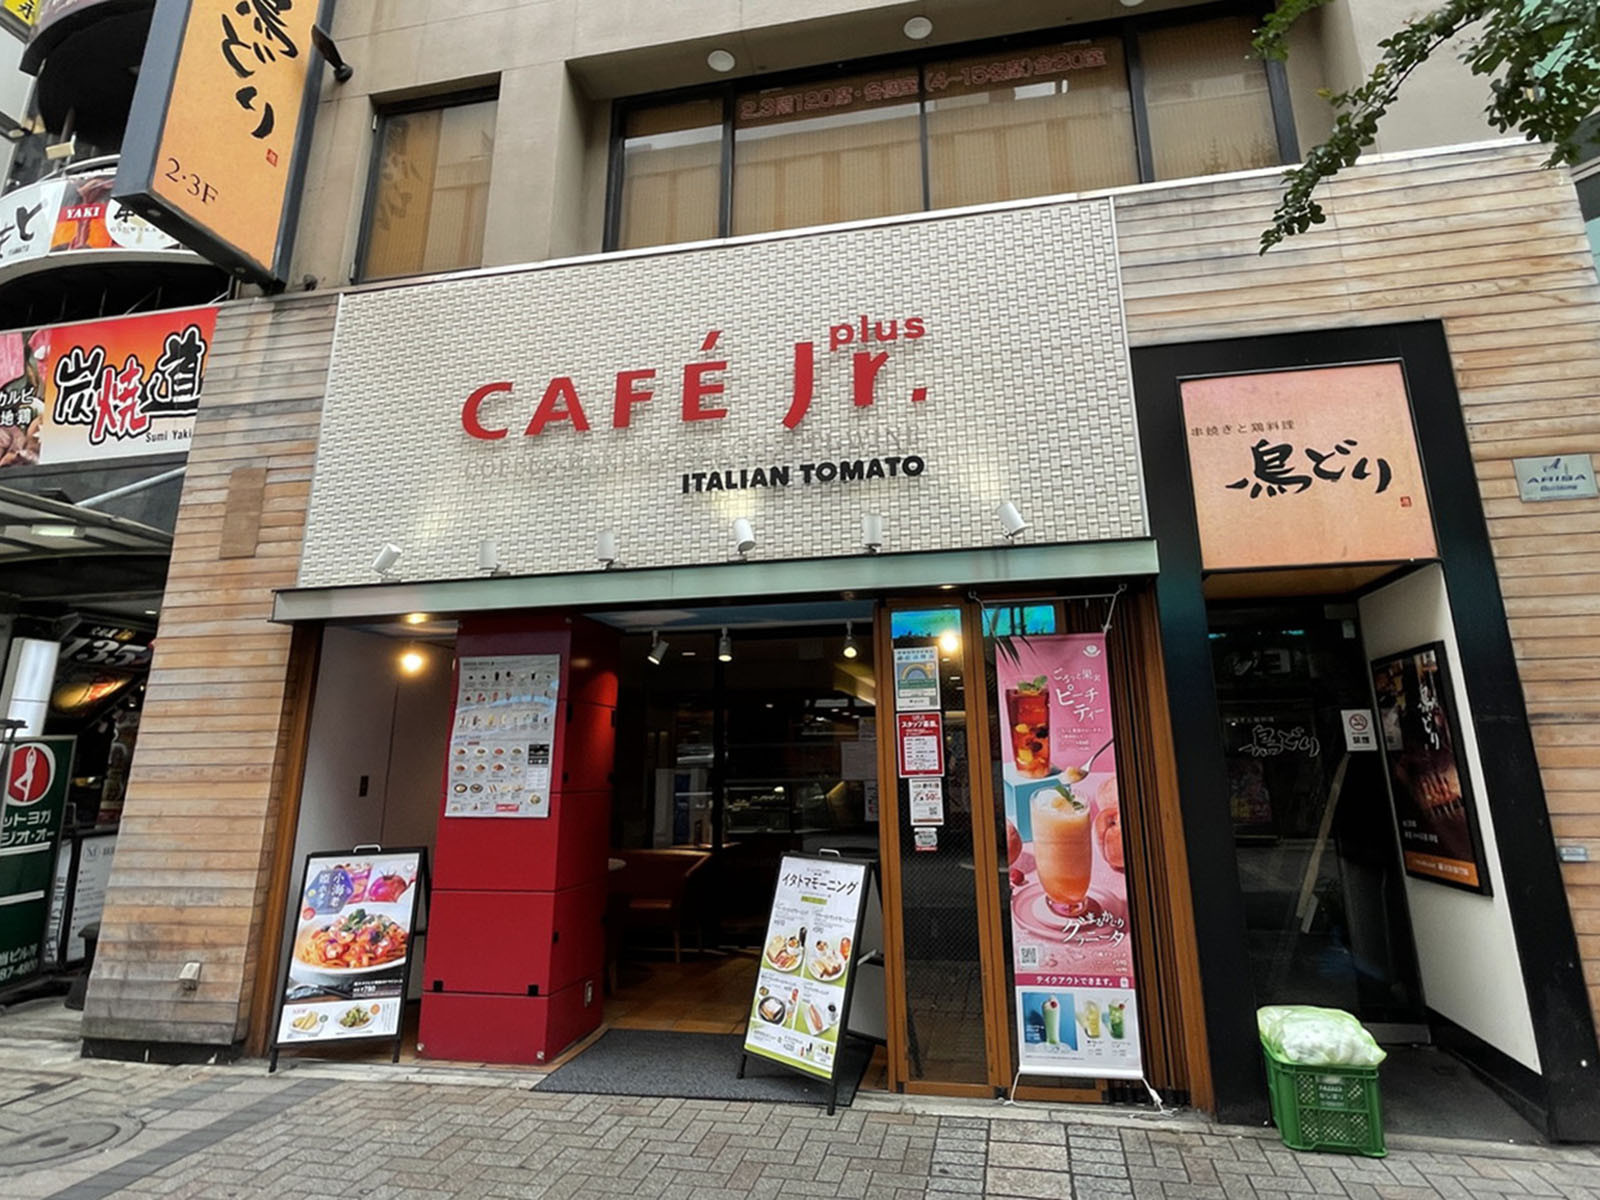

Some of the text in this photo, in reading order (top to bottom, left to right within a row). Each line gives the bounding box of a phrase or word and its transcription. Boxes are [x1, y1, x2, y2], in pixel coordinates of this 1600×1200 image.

[66, 205, 101, 220] YAKI
[829, 315, 926, 350] plus
[461, 330, 928, 441] CAFÉ Jr.
[145, 429, 193, 443] Sumi Yaki
[1190, 420, 1296, 438] 串焼きと鶏料理
[682, 455, 925, 494] ITALIAN TOMATO
[1225, 439, 1392, 499] 鳥どり
[1055, 684, 1099, 706] ピーチ
[1073, 703, 1105, 722] ティー
[782, 872, 859, 895] イタトマモーニング
